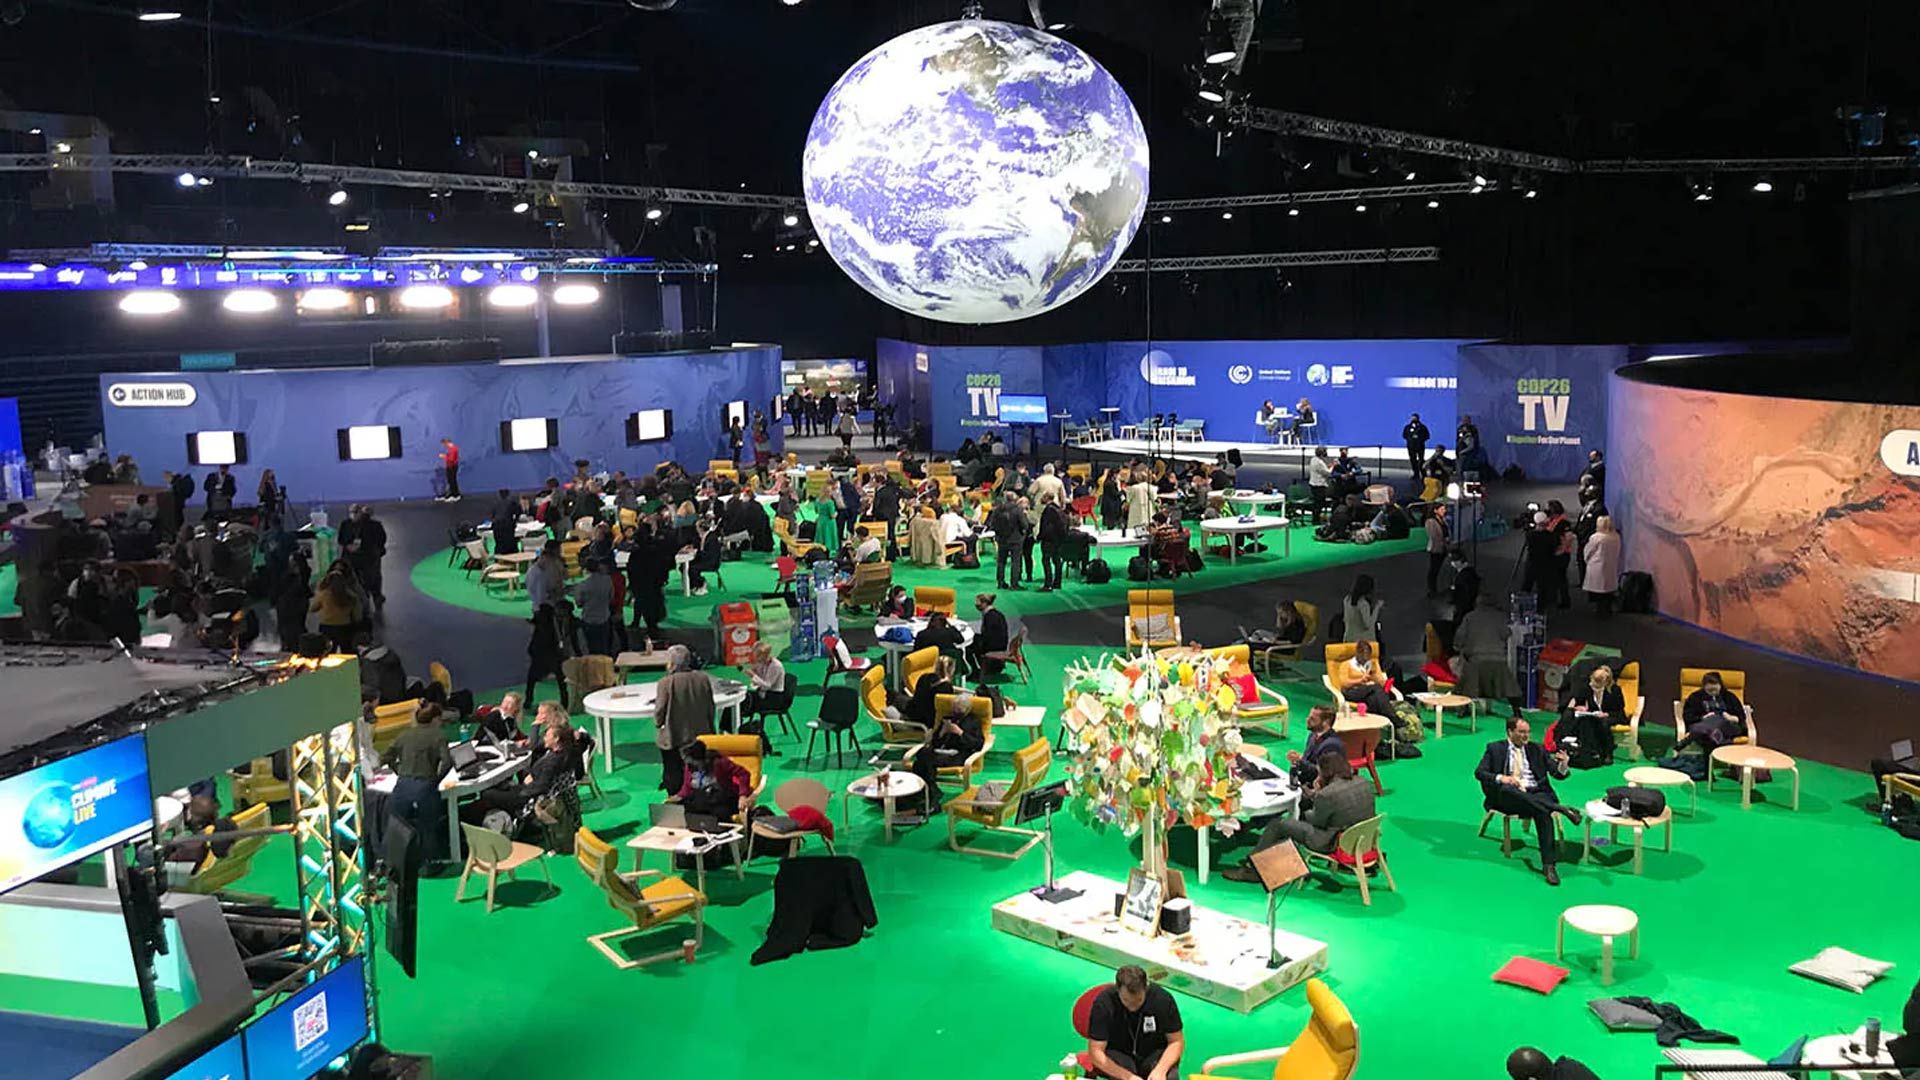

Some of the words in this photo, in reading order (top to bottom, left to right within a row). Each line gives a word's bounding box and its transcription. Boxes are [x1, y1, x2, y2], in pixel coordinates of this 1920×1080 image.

[131, 388, 164, 400] ACTION
[166, 388, 186, 400] HUB
[1517, 379, 1570, 394] COP26
[967, 387, 1001, 416] TV
[1518, 395, 1570, 431] TV
[74, 802, 97, 825] LIVE
